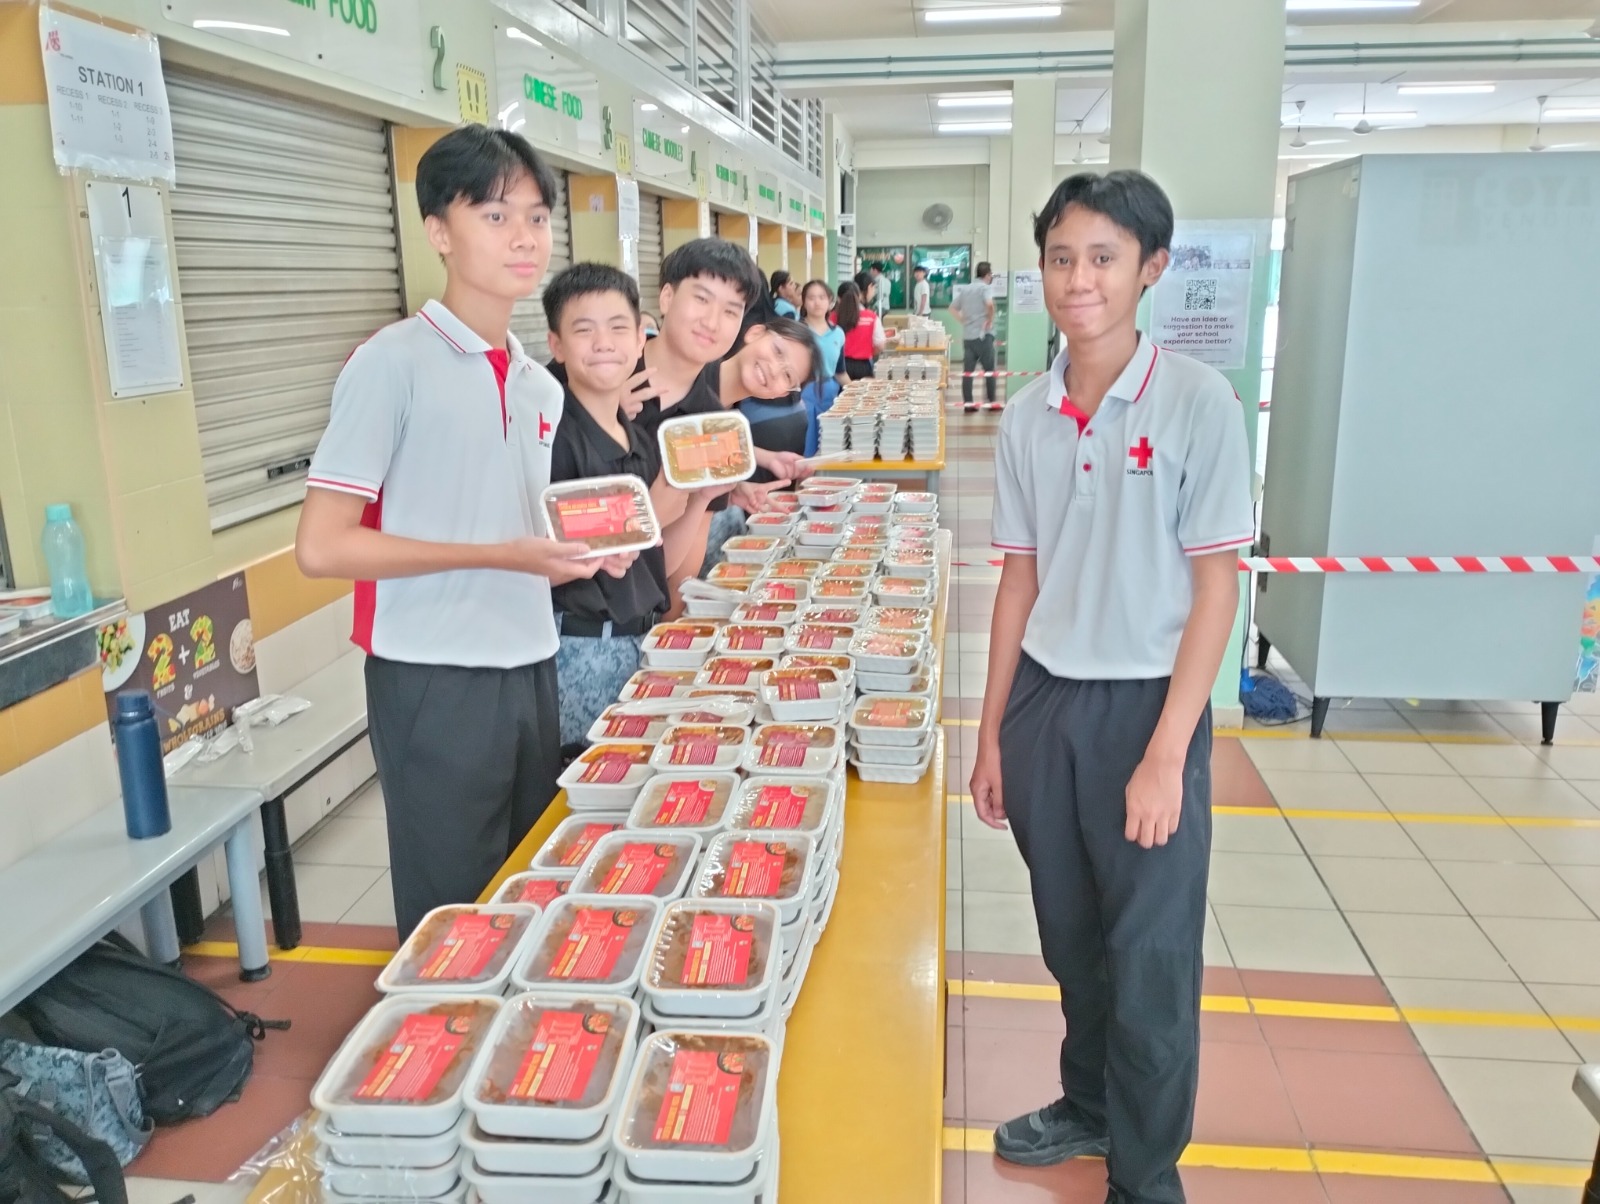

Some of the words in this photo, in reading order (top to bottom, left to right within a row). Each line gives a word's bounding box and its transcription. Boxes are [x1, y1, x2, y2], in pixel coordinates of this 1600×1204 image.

[430, 25, 447, 91] 2
[78, 66, 134, 95] STATION
[138, 81, 144, 97] 1
[56, 85, 84, 99] RECESS
[85, 92, 89, 100] 1
[97, 94, 123, 108] RECESS
[124, 101, 128, 109] 2
[523, 73, 558, 111] CHINESE
[561, 90, 583, 121] FOOD
[69, 101, 83, 112] 1-10
[133, 101, 159, 115] RECESS
[71, 114, 84, 124] 1-11
[602, 105, 613, 150] 3
[642, 127, 661, 154] CHINESE
[663, 138, 684, 163] NOODLES
[122, 186, 132, 218] 1
[1163, 323, 1203, 331] suggestion
[168, 608, 190, 633] EAT
[147, 633, 177, 691] 2
[189, 614, 217, 669] 2
[156, 681, 176, 699] FRUITS
[184, 683, 194, 701] &
